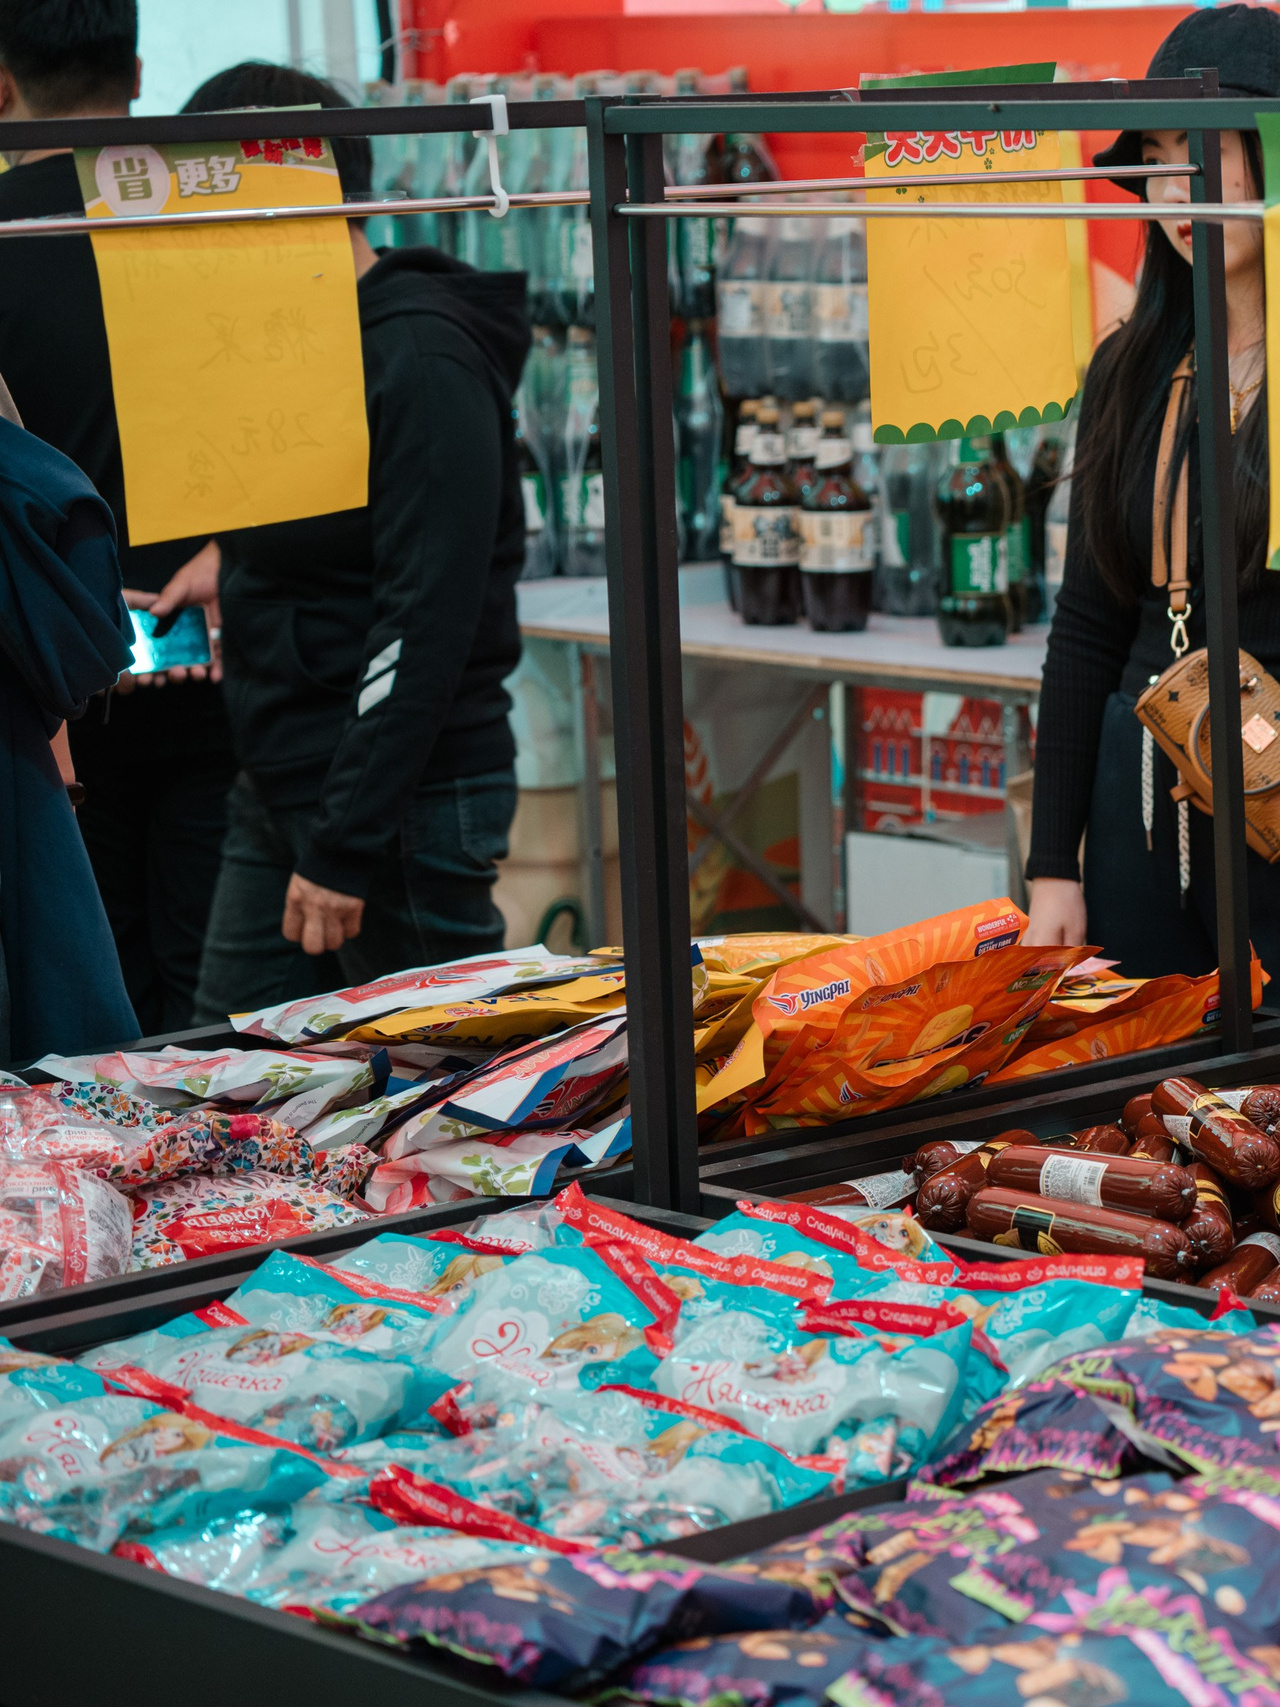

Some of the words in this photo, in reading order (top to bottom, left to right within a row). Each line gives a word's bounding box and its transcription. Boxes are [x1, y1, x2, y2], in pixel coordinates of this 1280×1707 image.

[977, 917, 1007, 933] WONDERFUL
[800, 979, 851, 1011] YINGPAI
[181, 1205, 271, 1228] КОНФЕТЫ
[588, 1214, 660, 1252] Сладуница
[682, 1360, 831, 1417] Няшечка
